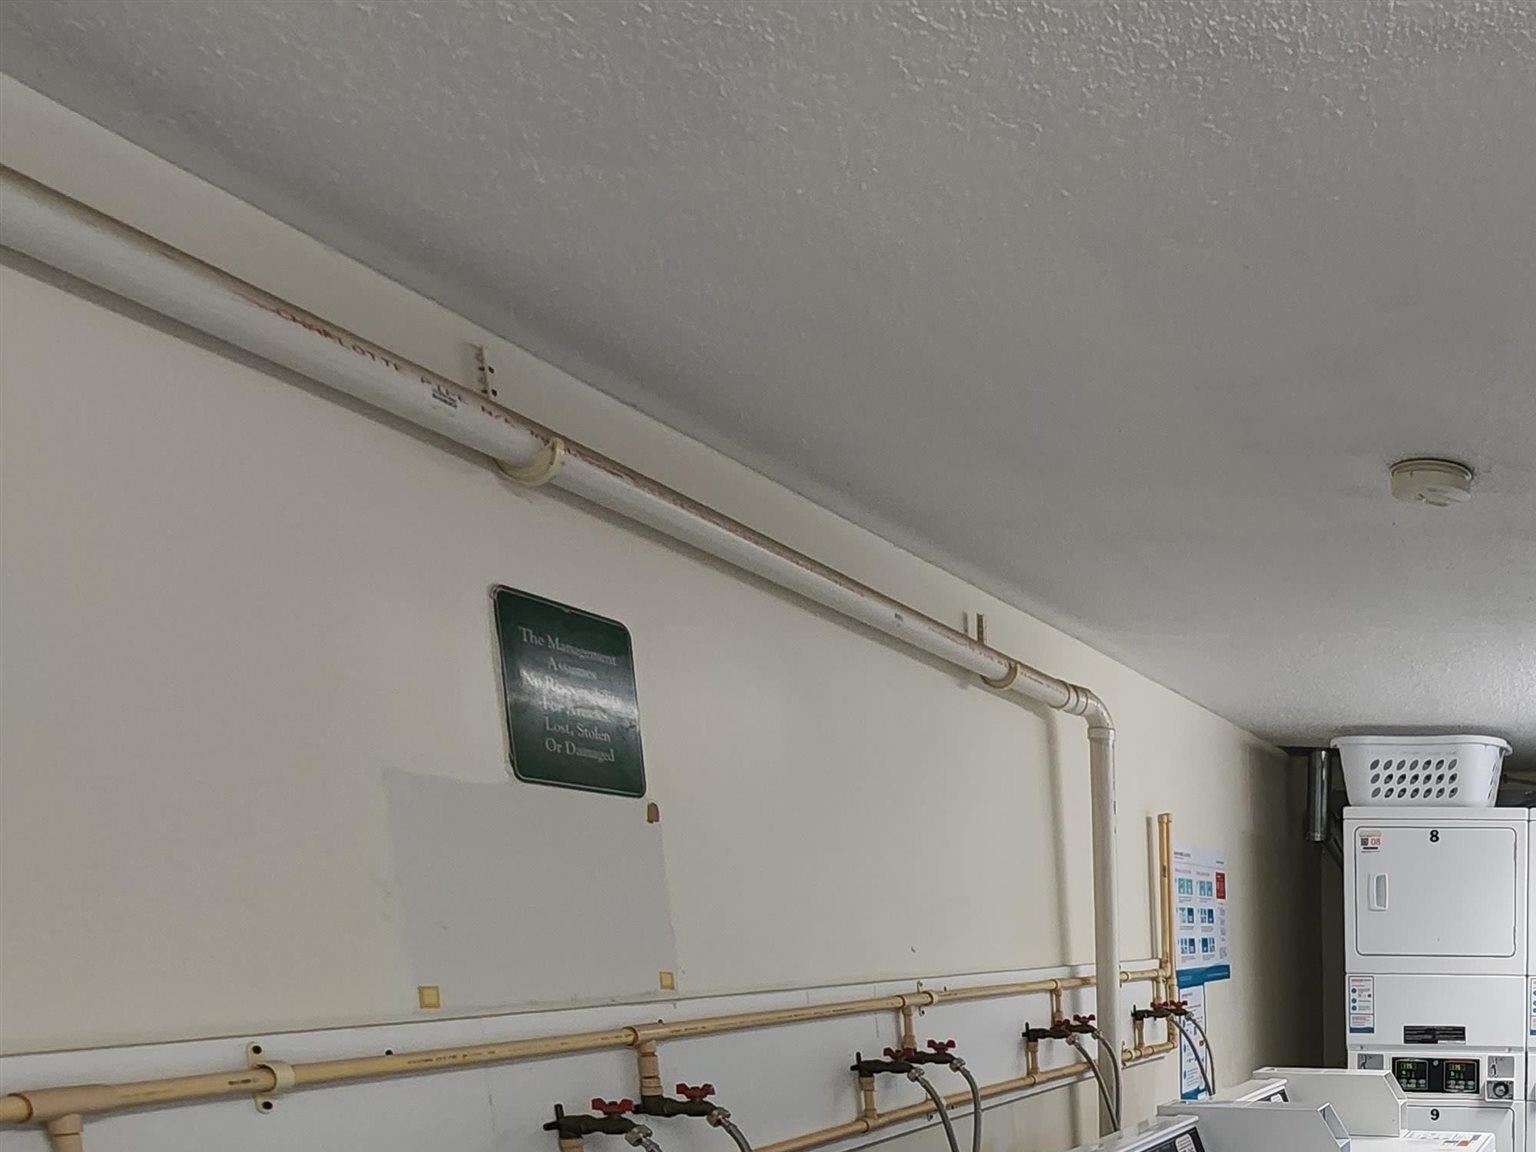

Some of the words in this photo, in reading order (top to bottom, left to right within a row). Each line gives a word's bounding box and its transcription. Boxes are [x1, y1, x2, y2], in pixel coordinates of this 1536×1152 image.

[518, 626, 545, 647] The
[548, 635, 617, 666] Management
[576, 722, 611, 744] Stolen
[545, 737, 563, 754] Or
[1429, 829, 1440, 844] 8
[1430, 1108, 1440, 1121] 9
